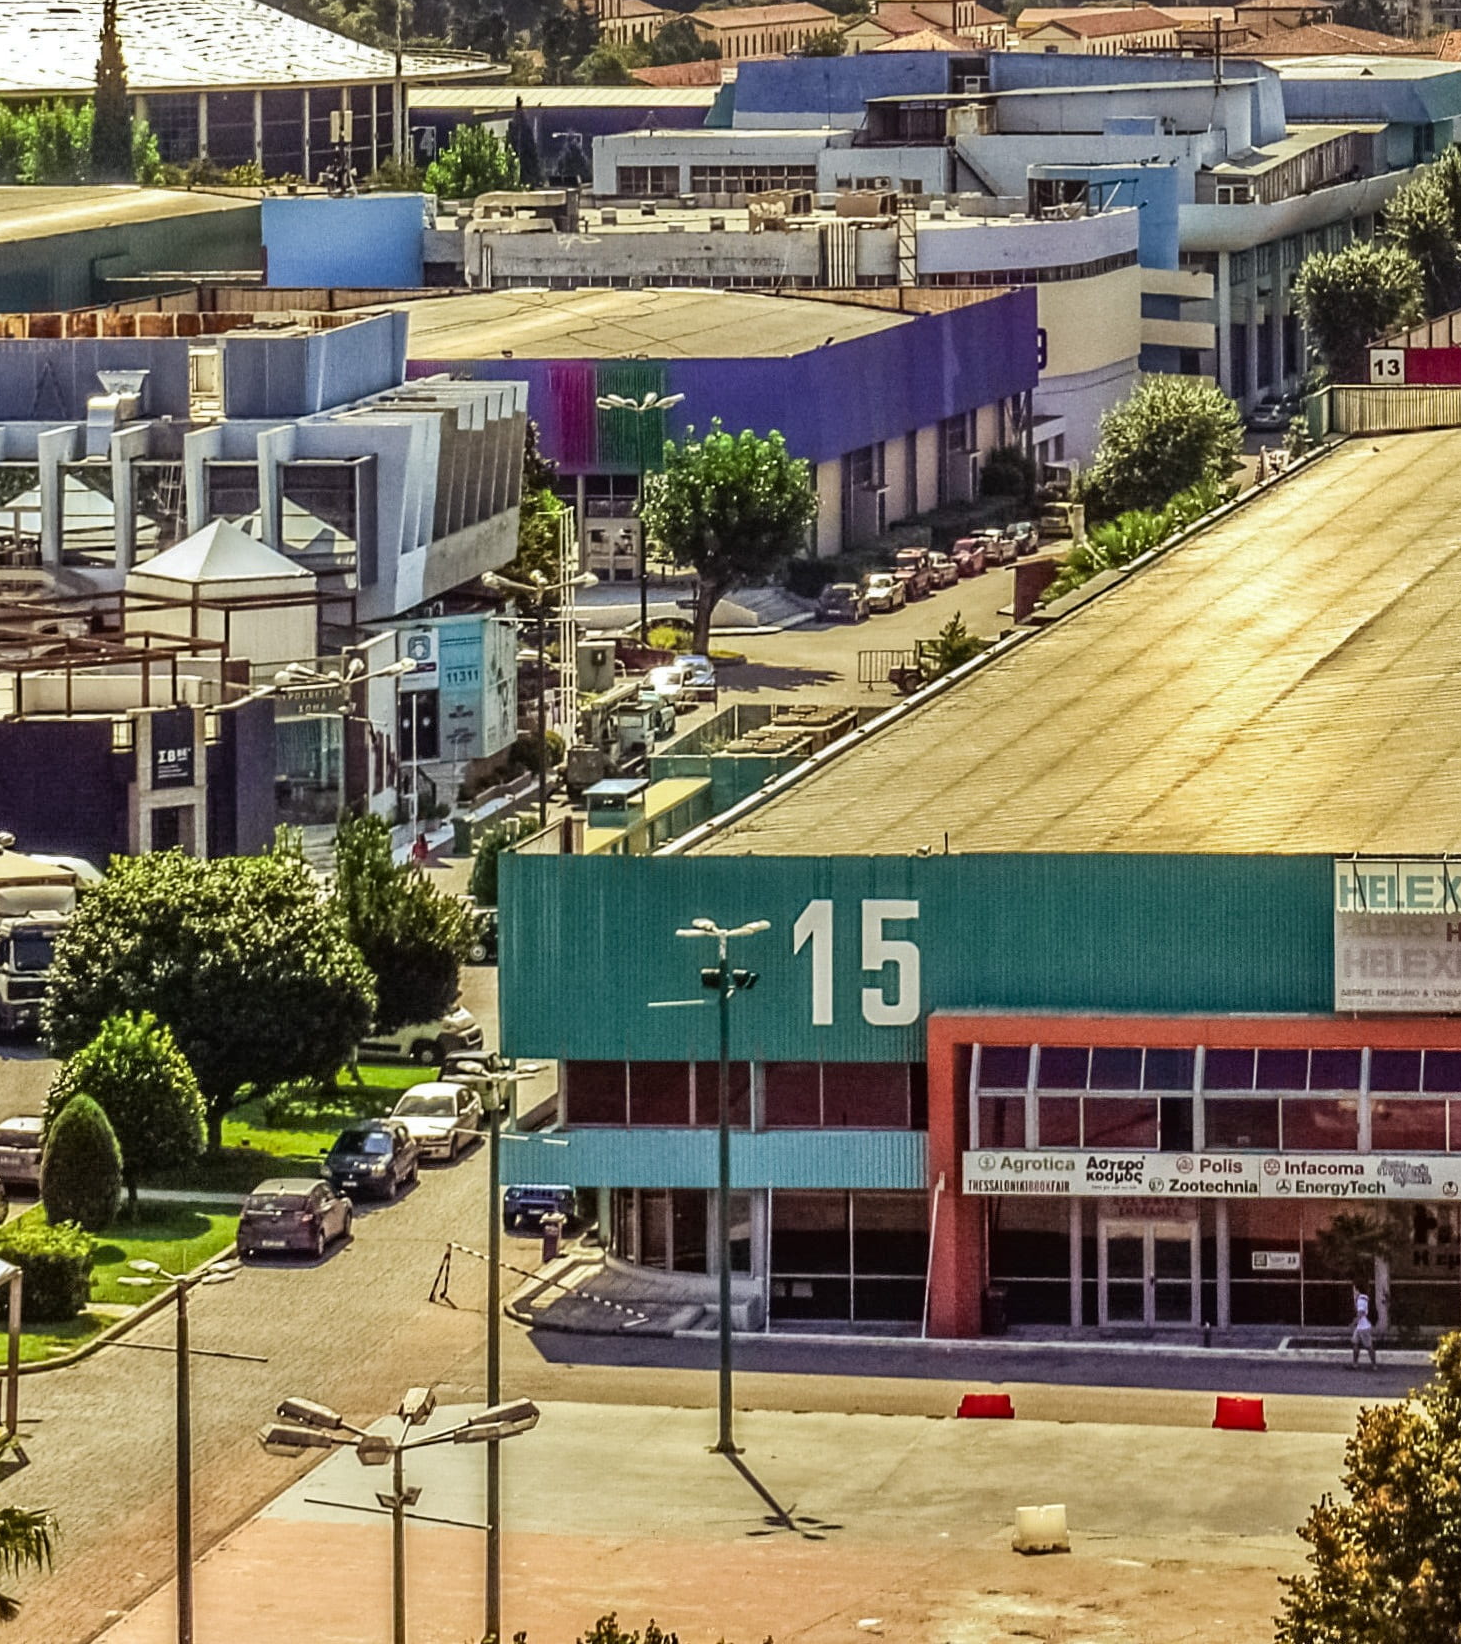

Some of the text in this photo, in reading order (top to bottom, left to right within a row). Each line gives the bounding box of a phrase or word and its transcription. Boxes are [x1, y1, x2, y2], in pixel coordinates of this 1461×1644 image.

[1374, 359, 1400, 376] 13
[446, 669, 480, 684] 11311
[793, 899, 921, 1026] 15
[1000, 1157, 1076, 1174] Agrotica
[1200, 1159, 1243, 1174] Polis
[1284, 1161, 1364, 1175] Infacoma
[1169, 1180, 1258, 1193] Zootechnia
[1296, 1179, 1386, 1197] EnergyTech
